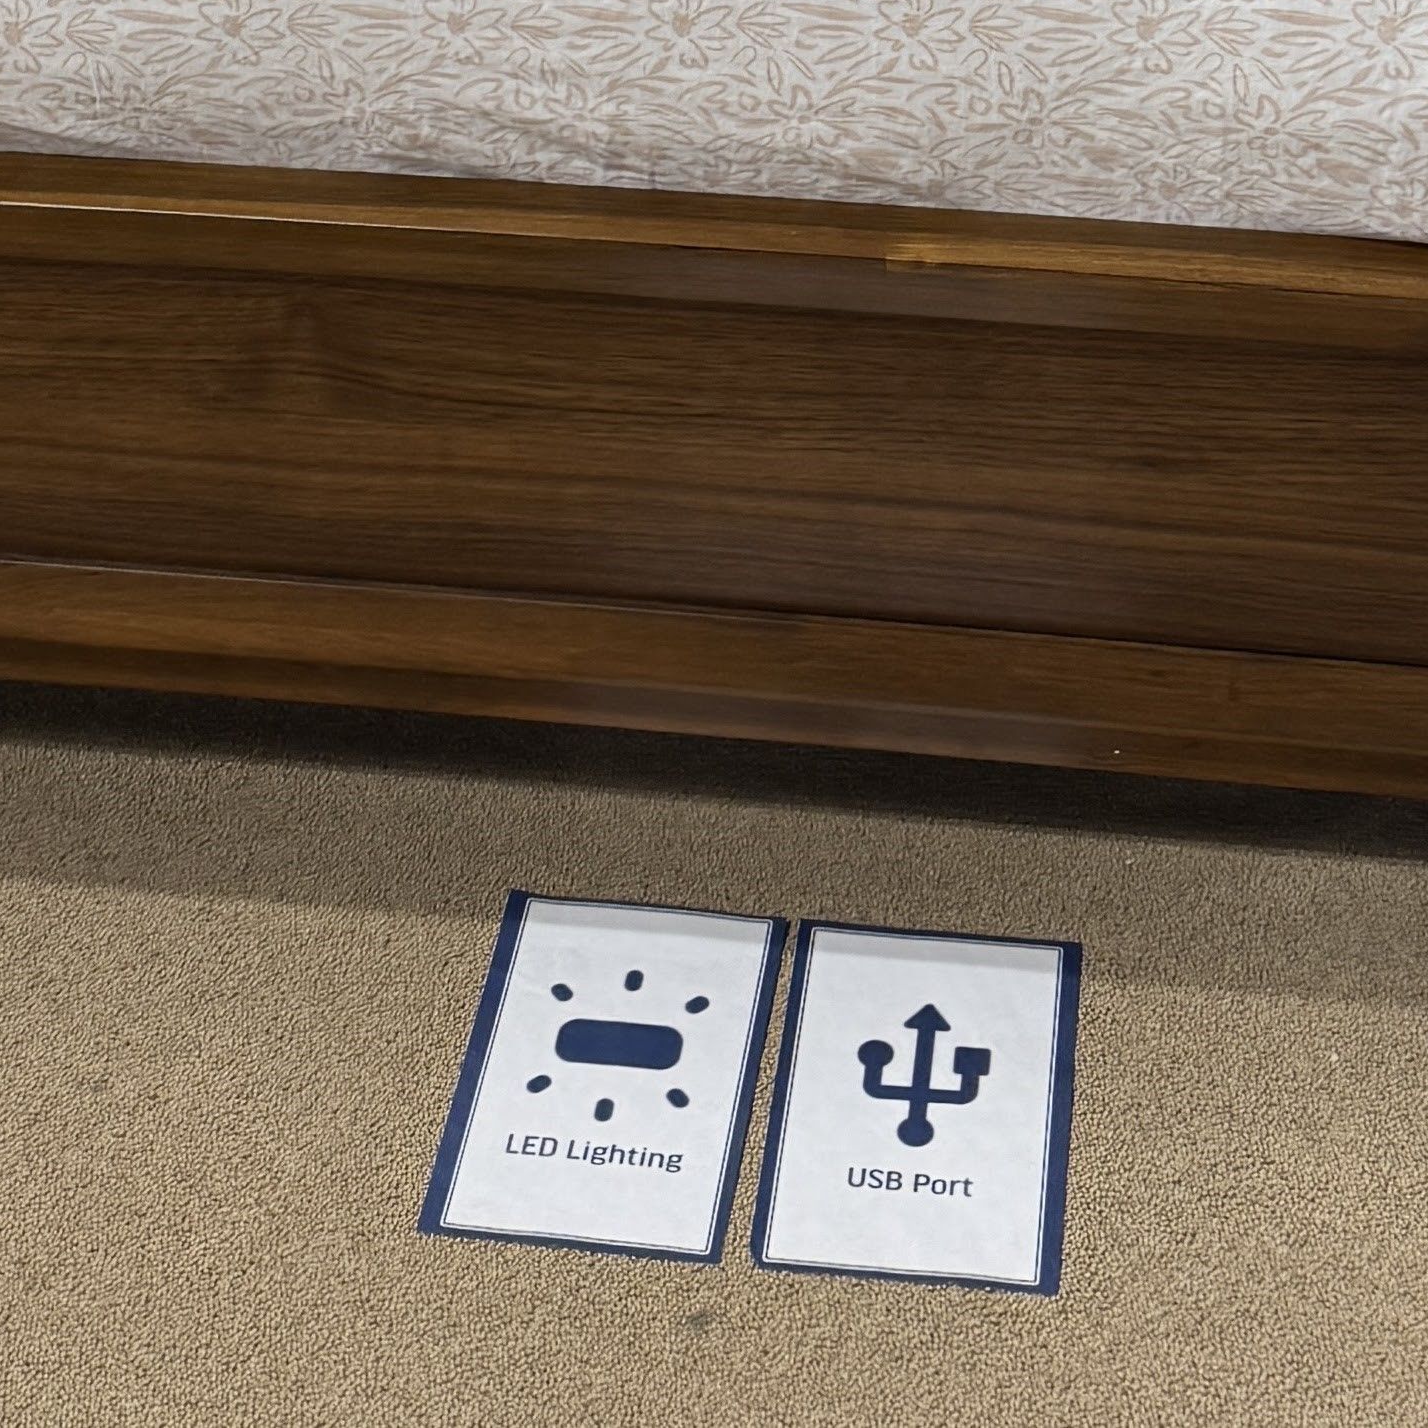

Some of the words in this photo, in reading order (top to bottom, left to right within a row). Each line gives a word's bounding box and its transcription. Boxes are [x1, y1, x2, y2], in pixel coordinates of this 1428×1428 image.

[505, 1133, 559, 1157] LED
[566, 1139, 684, 1173] Lighting
[847, 1166, 903, 1191] USB
[912, 1173, 974, 1197] Port
